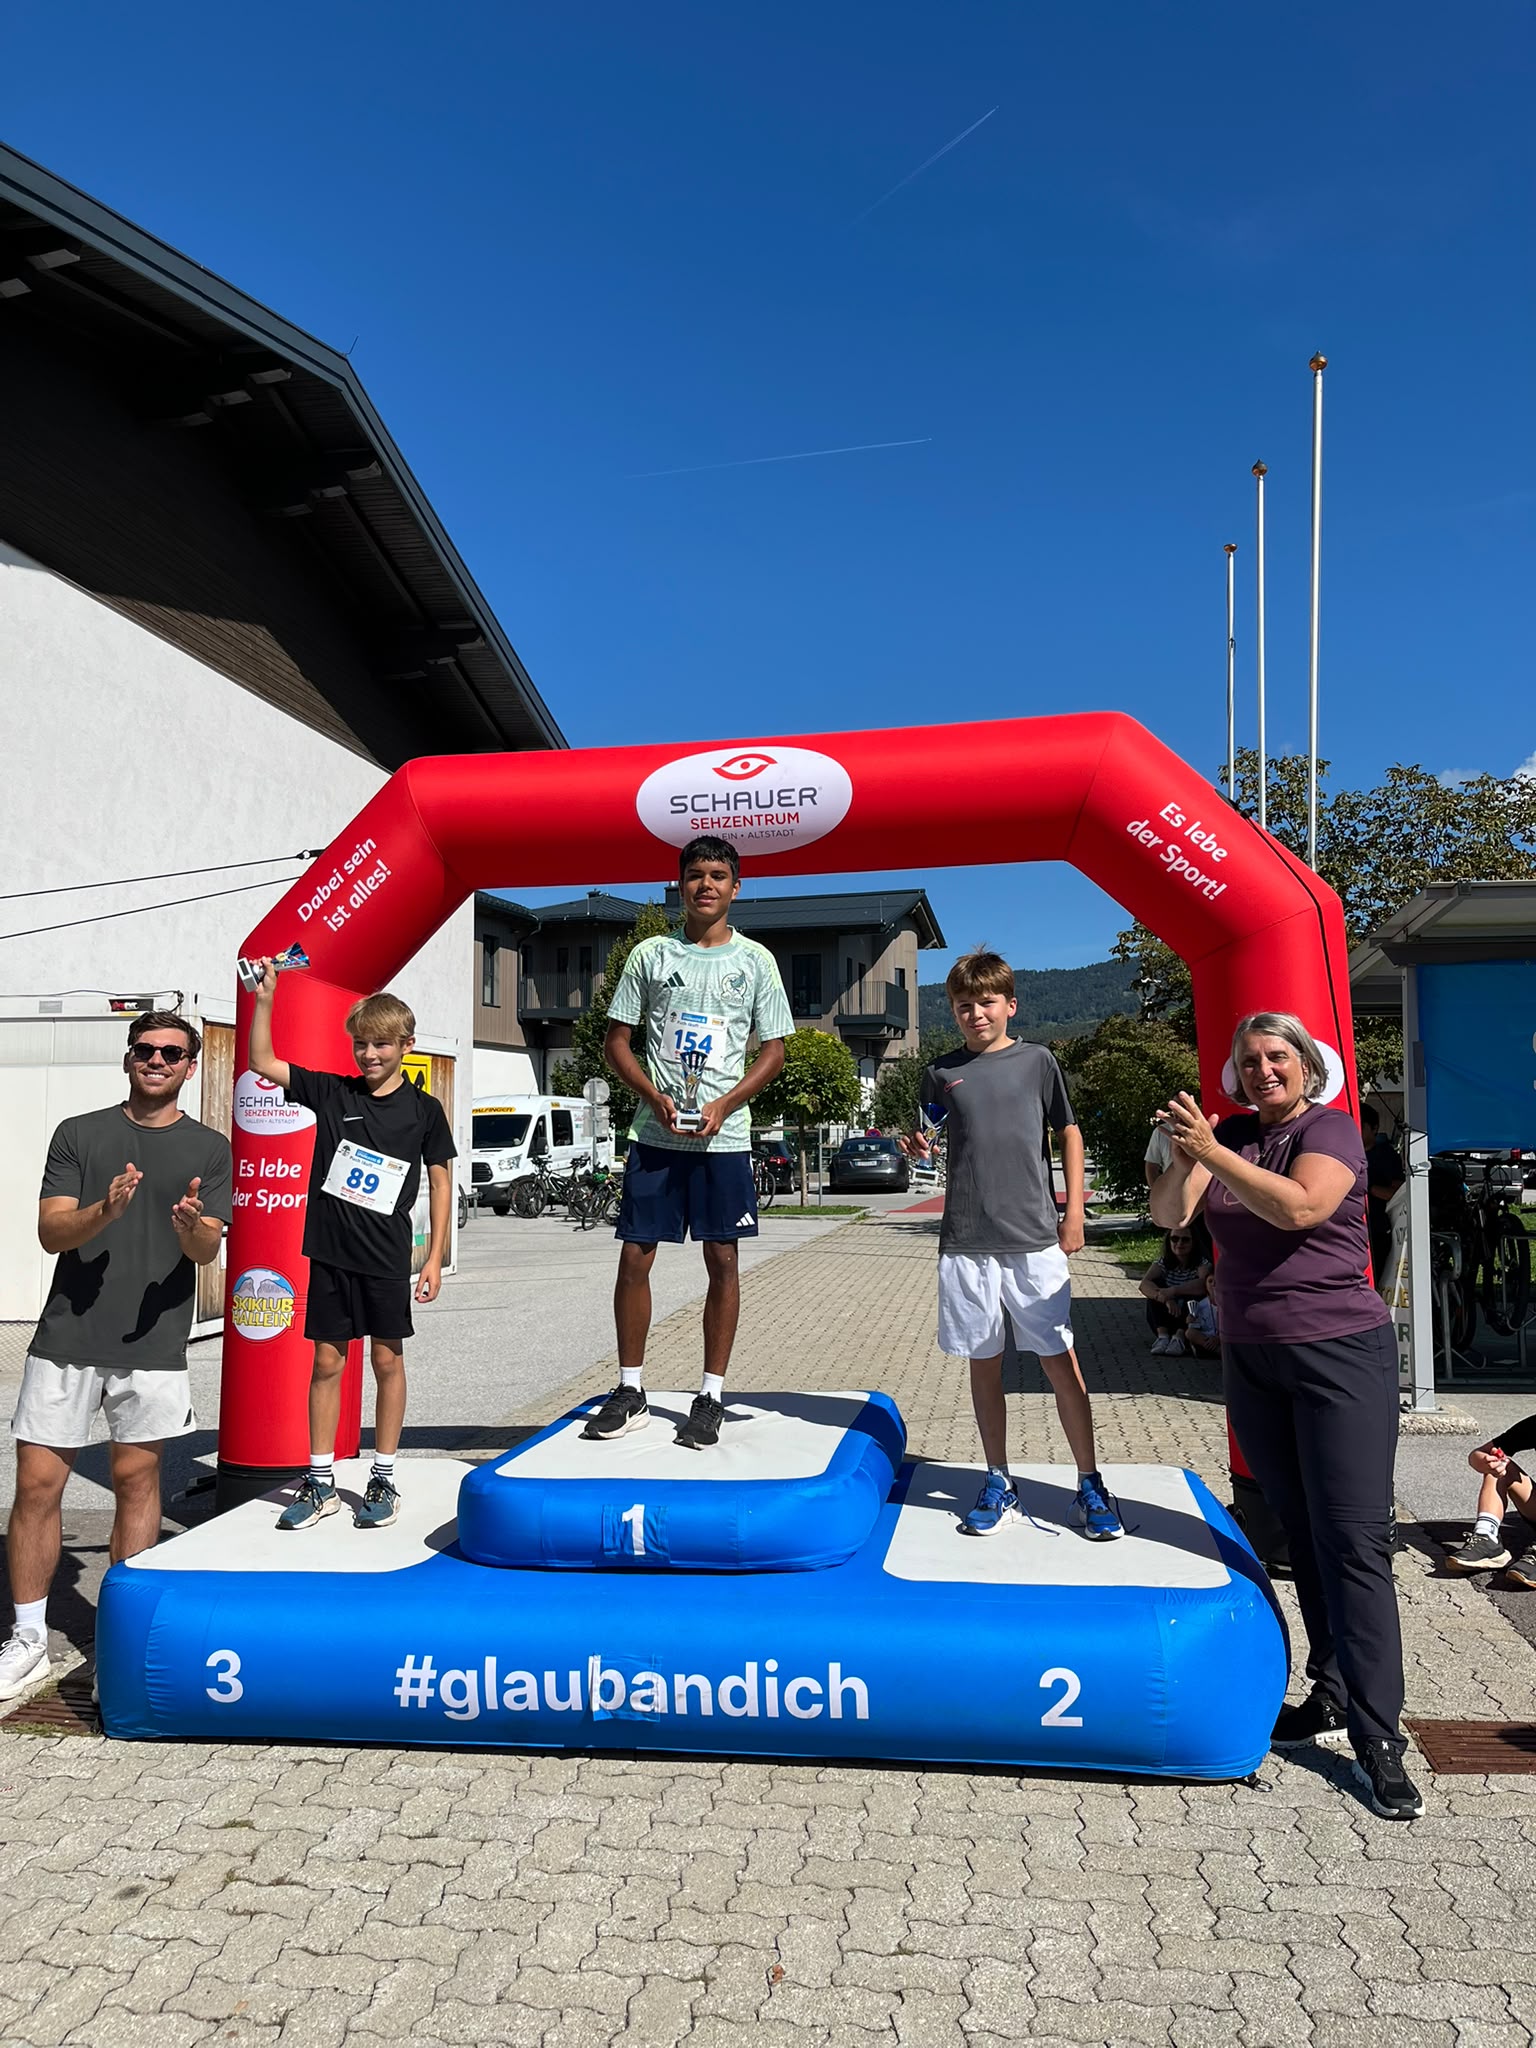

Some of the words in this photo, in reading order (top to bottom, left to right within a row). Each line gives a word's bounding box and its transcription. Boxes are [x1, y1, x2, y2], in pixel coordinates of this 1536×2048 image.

[670, 787, 818, 814] SCHAUER
[690, 812, 800, 830] SEHZENTRUM
[1159, 802, 1187, 828] Es
[1184, 821, 1228, 862] lebe
[747, 829, 795, 839] ALTSTADT
[1126, 819, 1164, 848] der
[1159, 844, 1228, 901] Sport!
[297, 868, 344, 922] Dabei
[343, 838, 377, 875] sein
[323, 903, 352, 932] ist
[349, 859, 392, 910] alles!
[674, 1029, 713, 1054] 154
[239, 1096, 303, 1108] SCHAU
[244, 1109, 299, 1117] SEHZENTRUM
[239, 1159, 255, 1177] Es
[259, 1158, 302, 1178] lebe
[346, 1167, 379, 1194] 89
[232, 1187, 252, 1206] der
[232, 1295, 294, 1312] SKIKLUB
[232, 1311, 292, 1327] HALLEIN
[621, 1503, 646, 1556] 1
[205, 1649, 245, 1703] 3
[393, 1655, 870, 1721] #glaubandich
[1038, 1667, 1083, 1728] 2
